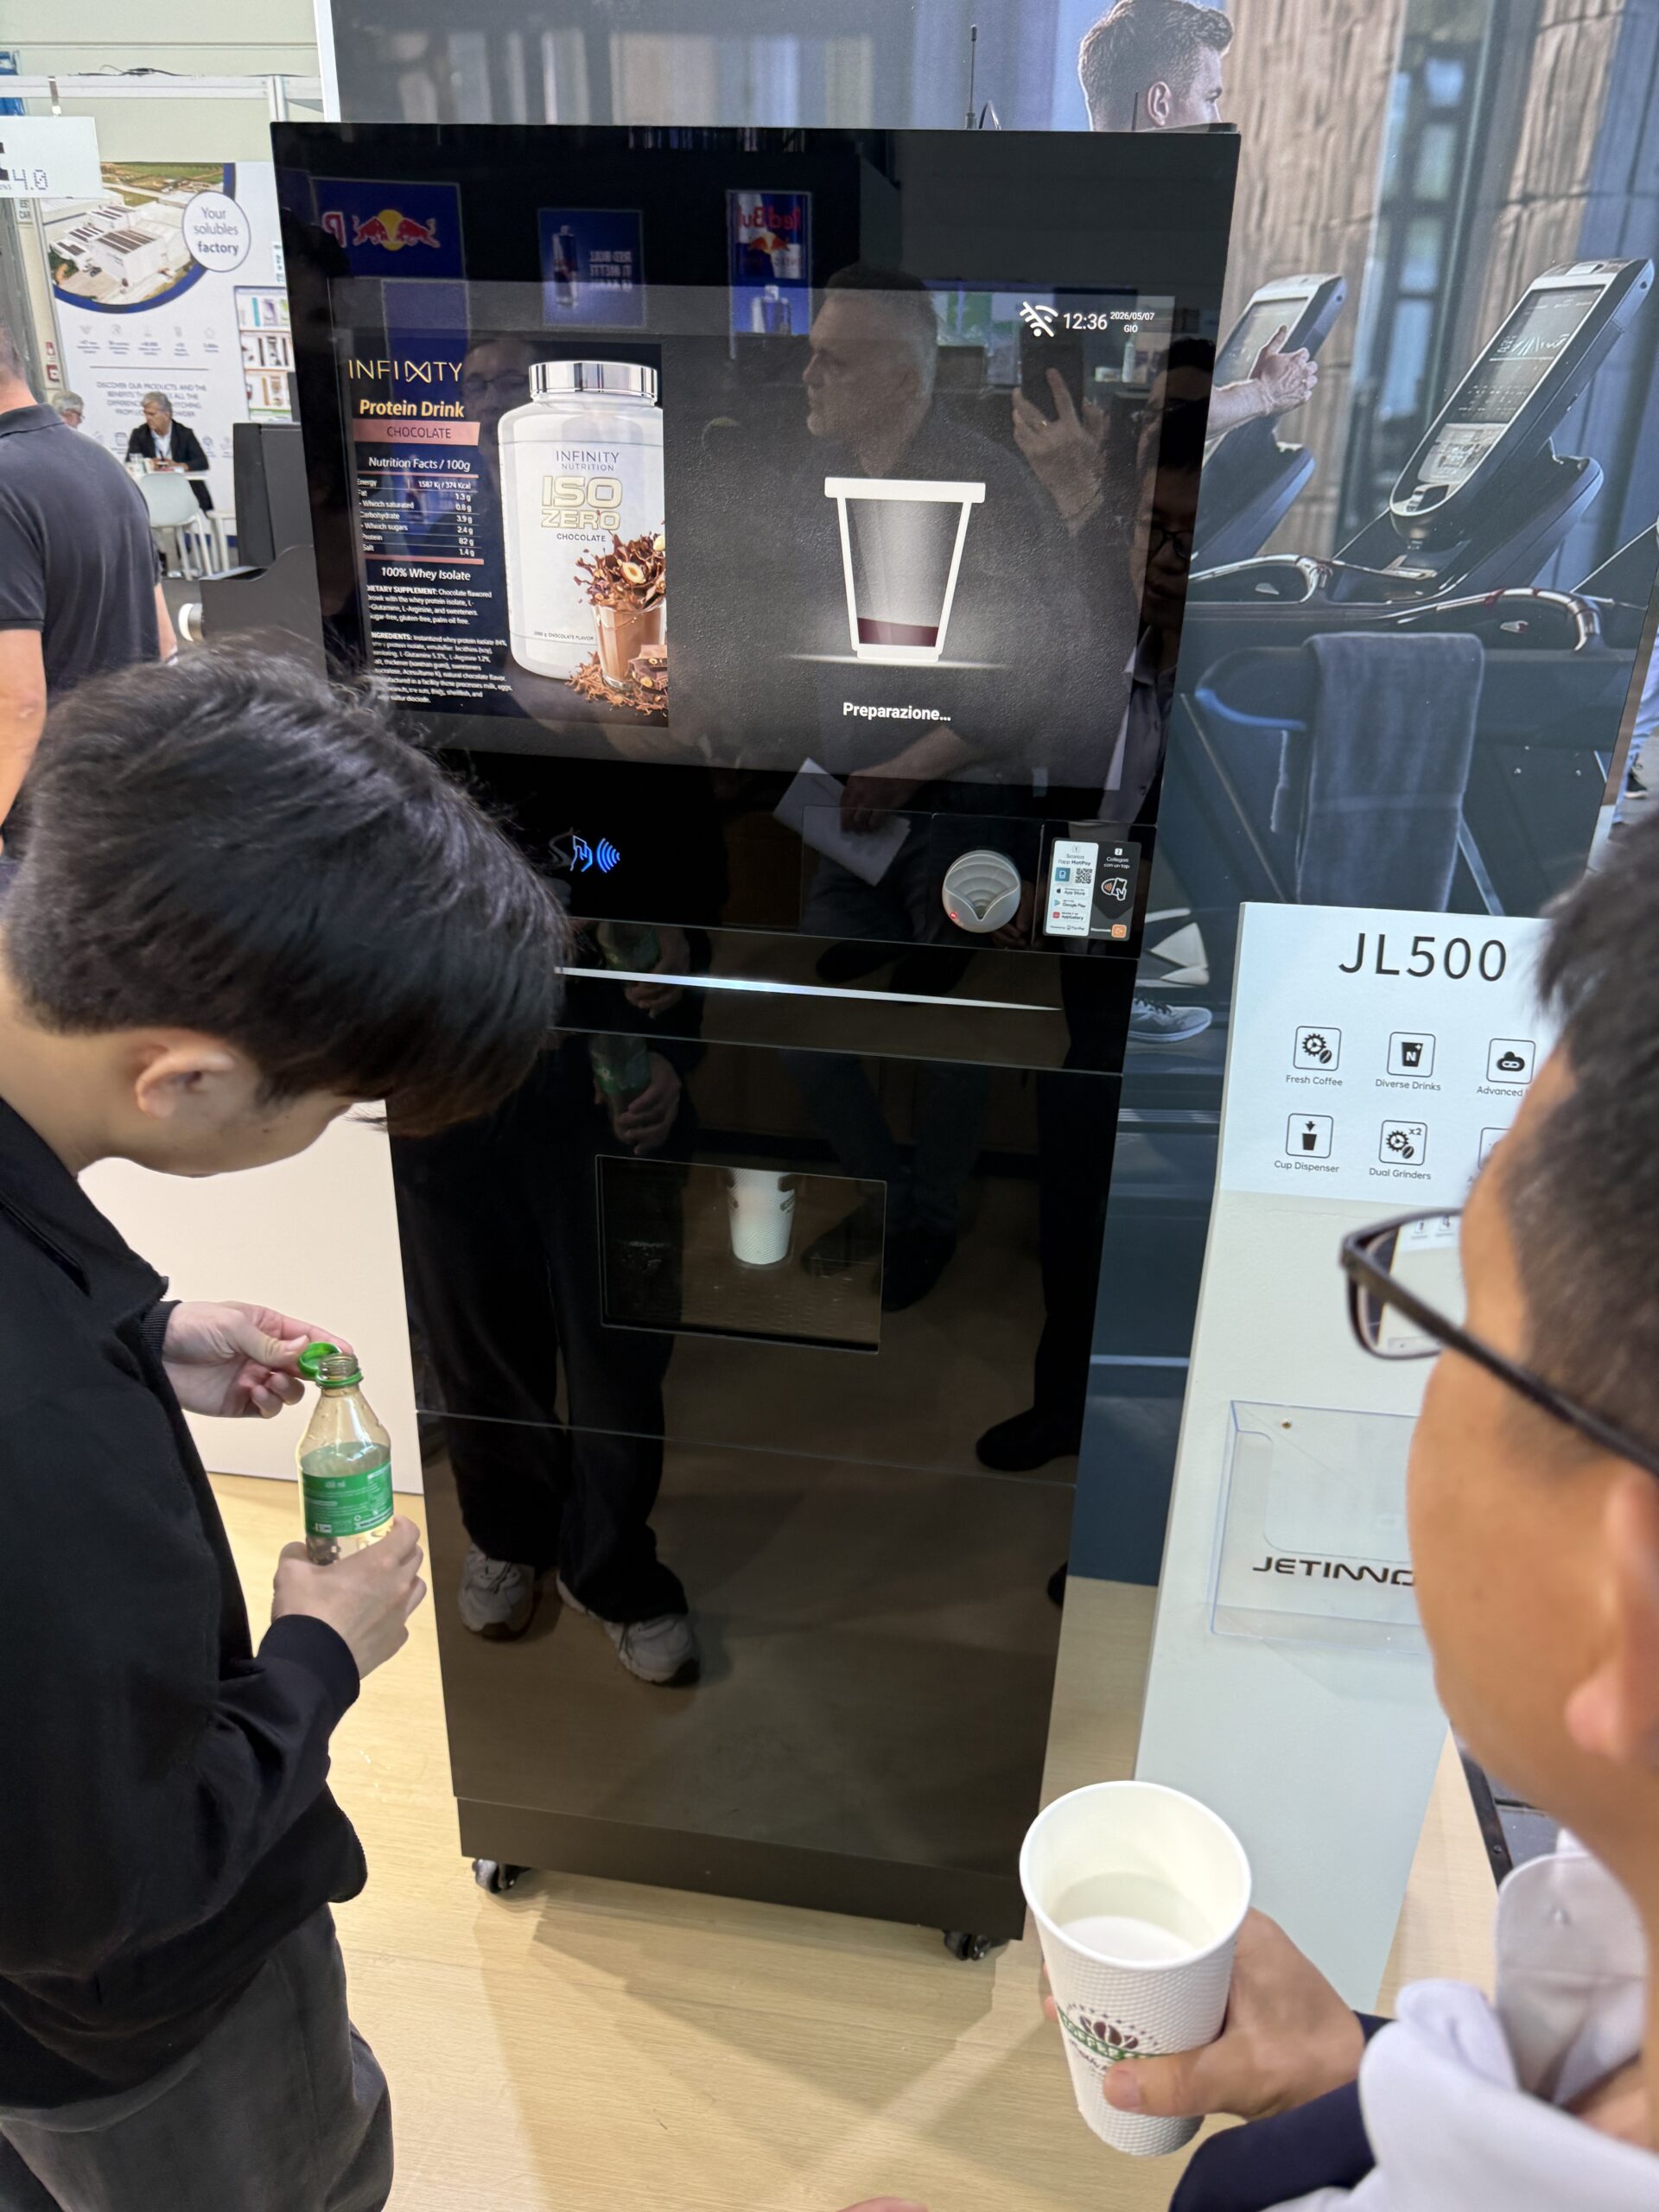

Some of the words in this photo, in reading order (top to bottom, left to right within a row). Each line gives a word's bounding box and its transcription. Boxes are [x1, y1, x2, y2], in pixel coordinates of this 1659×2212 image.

[201, 207, 226, 219] Your
[194, 223, 239, 236] solubles
[197, 240, 239, 257] factory
[1063, 313, 1109, 331] 12:36
[1109, 311, 1155, 321] 2026/05/07
[1123, 324, 1139, 334] GIO
[359, 398, 417, 416] Protein
[421, 401, 465, 418] Drink
[386, 426, 452, 439] CHOCOLATE
[556, 450, 620, 463] INFINITY
[368, 456, 410, 468] Nutrition
[413, 458, 438, 469] Facts
[446, 460, 471, 473] 100g
[561, 463, 614, 473] NUTRITION
[542, 474, 624, 510] ISO
[541, 508, 621, 531] ZERO
[556, 532, 607, 543] CHOCOLATE
[381, 566, 408, 578] 100%
[409, 568, 436, 581] Whey
[438, 569, 471, 581] Isolate
[371, 632, 413, 641] NGREDIENTS:
[842, 702, 951, 721] Preparazione...
[1338, 932, 1507, 982] JL500
[1286, 1074, 1311, 1085] Fresh
[1313, 1076, 1343, 1087] Coffee
[1375, 1078, 1410, 1090] Diverse
[1412, 1080, 1441, 1091] Drinks
[1476, 1085, 1523, 1097] Advanced
[1408, 1127, 1422, 1136] x2
[1274, 1160, 1293, 1170] Cup
[1294, 1161, 1339, 1173] Dispenser
[1369, 1167, 1390, 1177] Dual
[1392, 1169, 1432, 1180] Grinders
[1252, 1556, 1414, 1586] JETINNO
